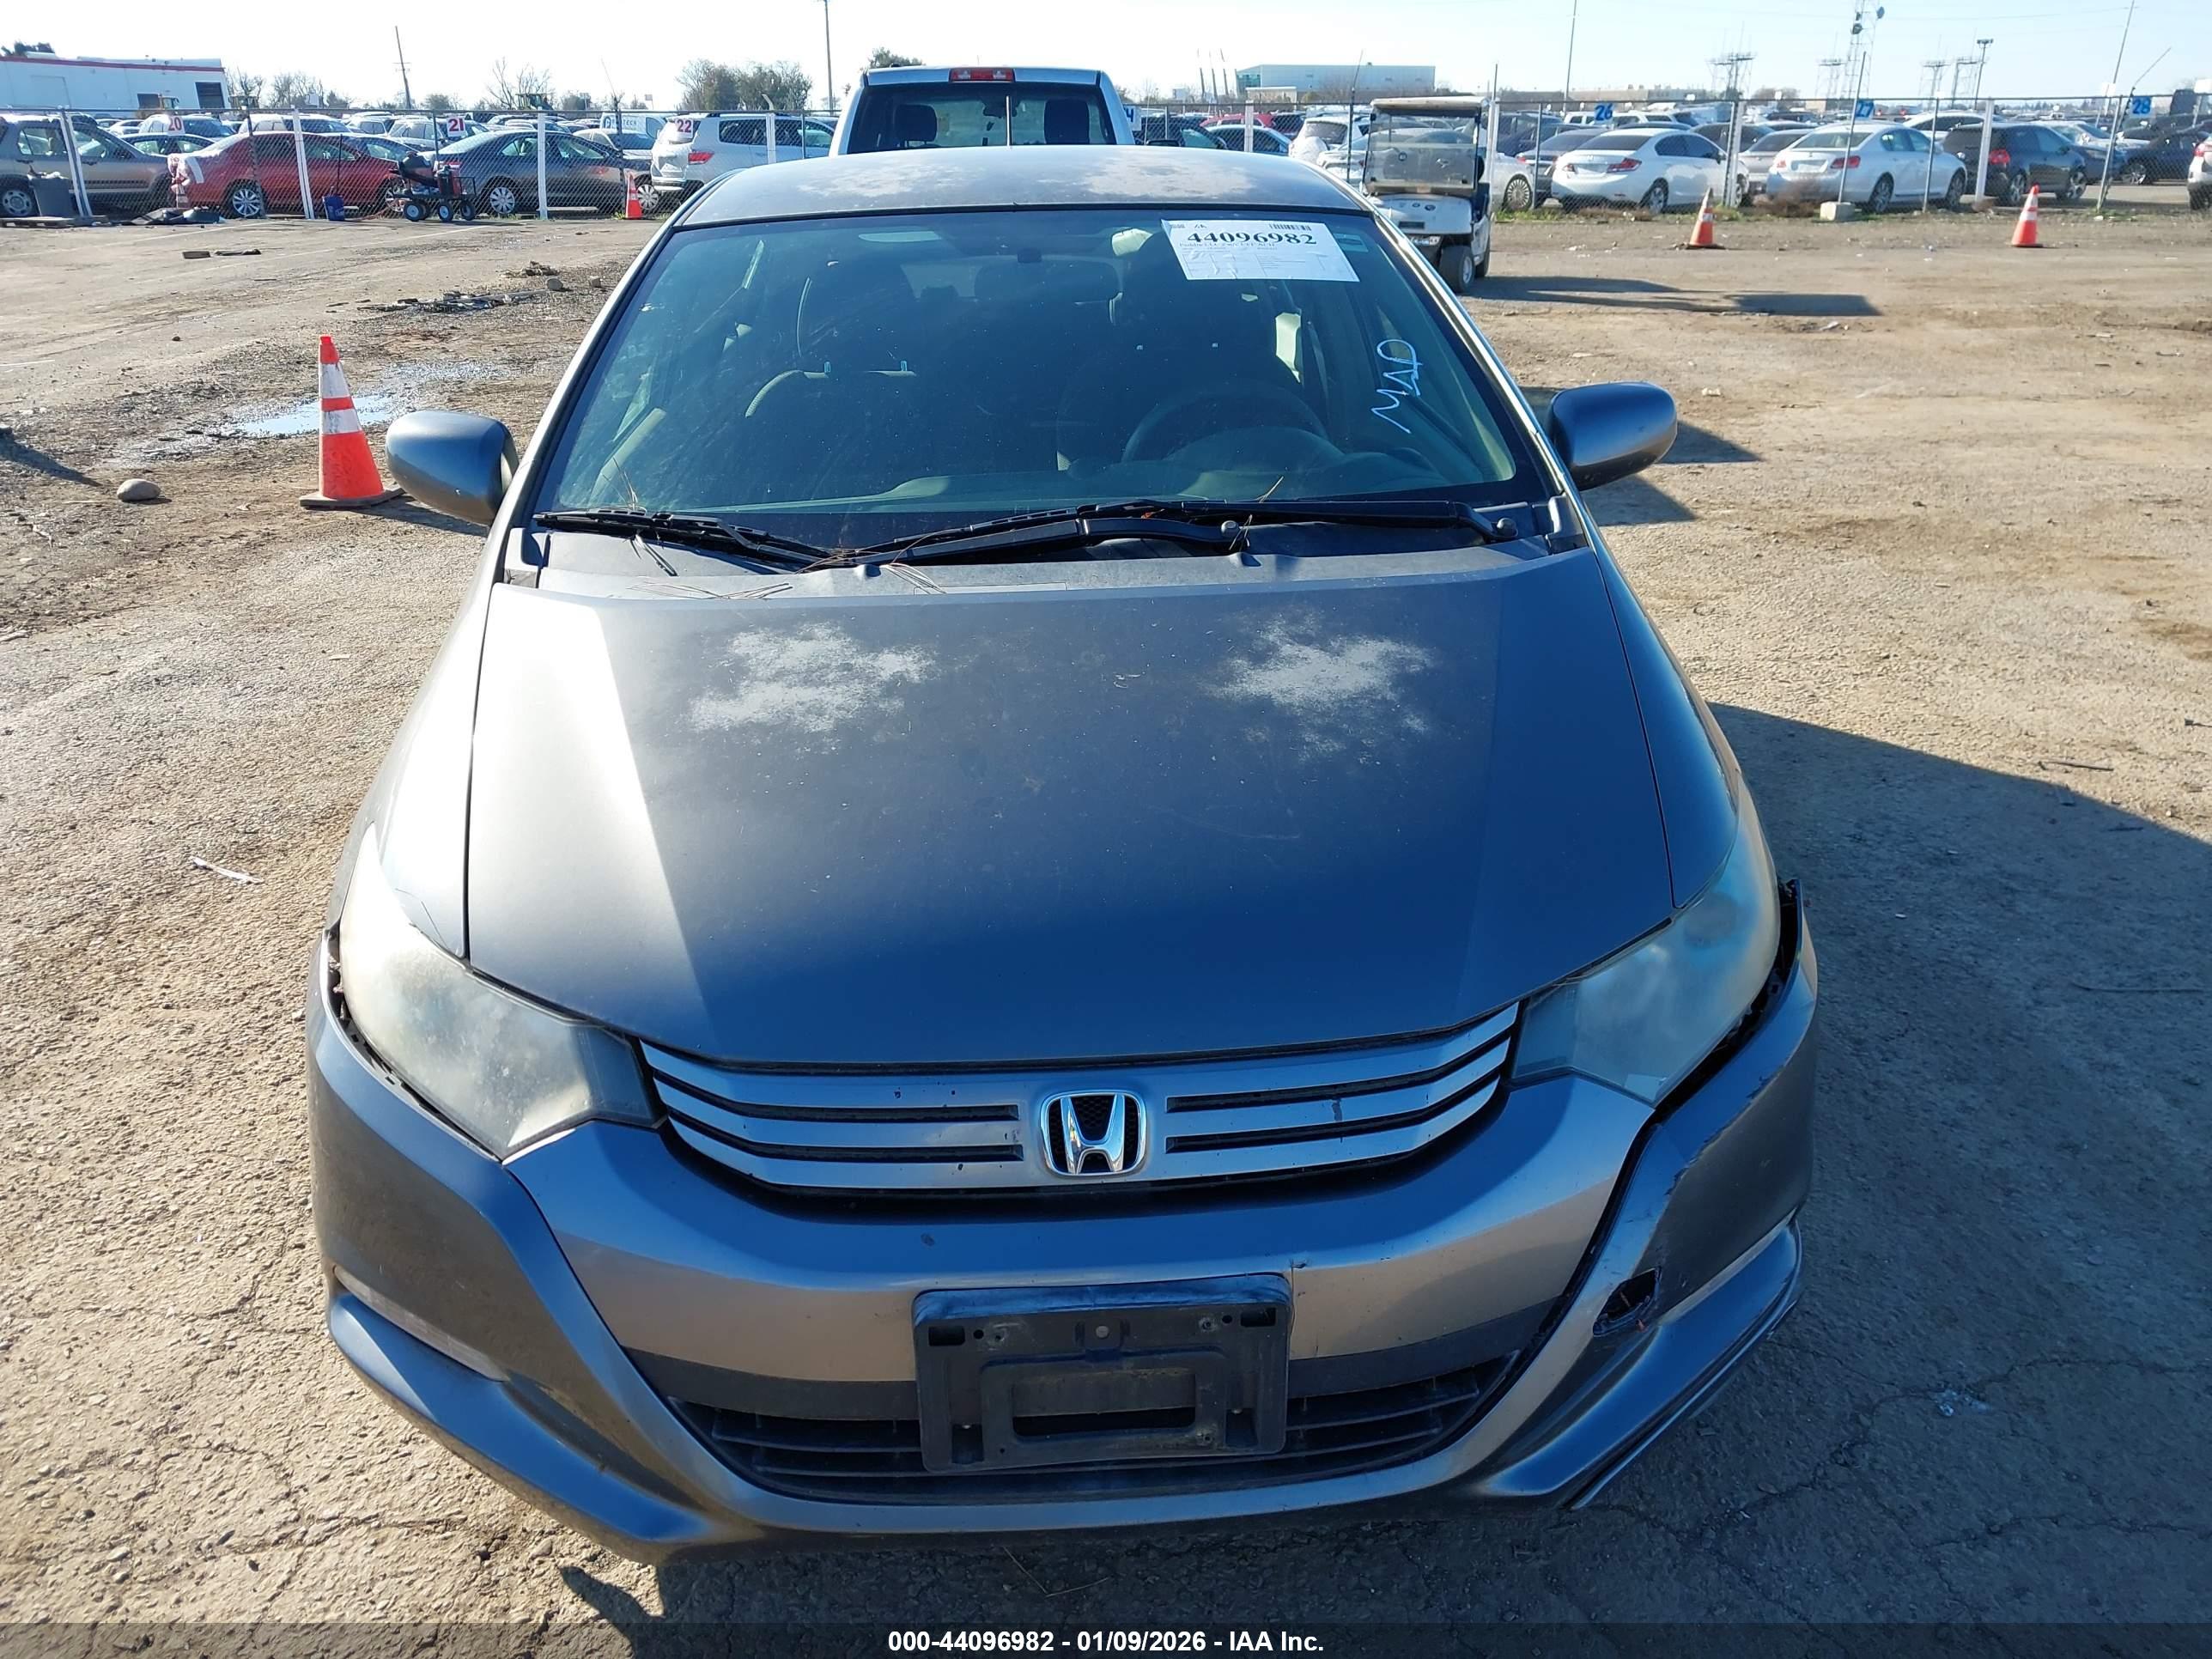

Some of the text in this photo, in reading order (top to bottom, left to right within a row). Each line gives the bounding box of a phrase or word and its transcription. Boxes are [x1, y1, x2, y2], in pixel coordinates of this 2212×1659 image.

[1595, 105, 1612, 120] 26
[1856, 100, 1873, 118] 27
[2132, 99, 2150, 114] 28
[1123, 107, 1134, 122] 4
[168, 117, 182, 131] 20
[448, 118, 464, 131] 21
[677, 119, 692, 133] 22
[1188, 232, 1316, 244] 44096982
